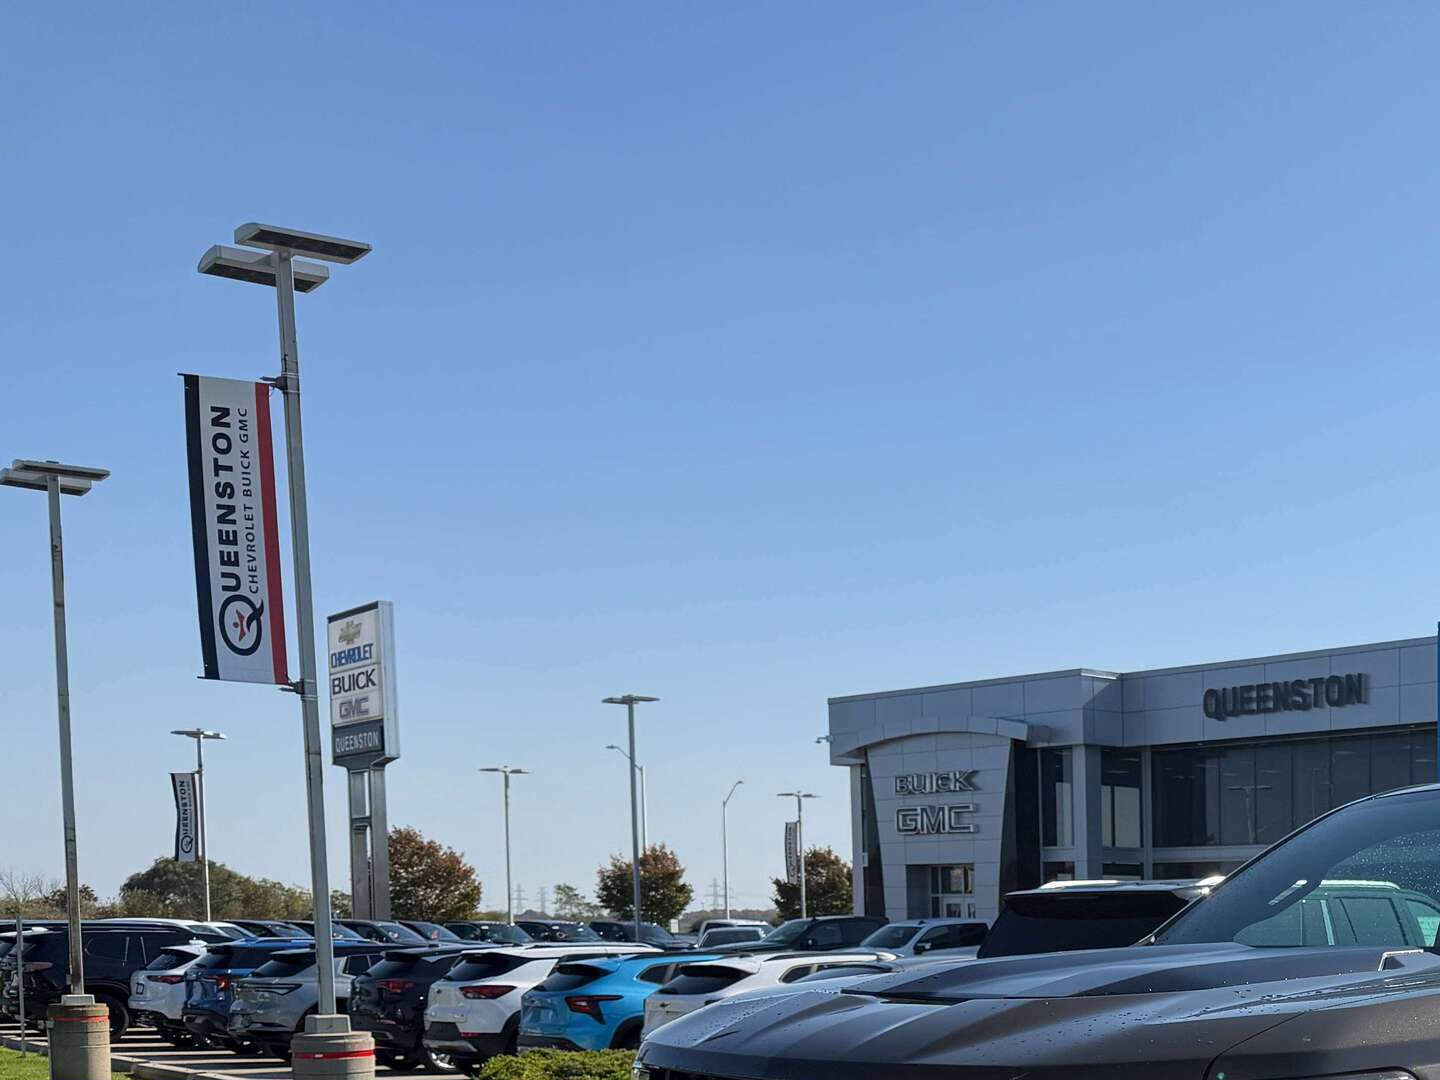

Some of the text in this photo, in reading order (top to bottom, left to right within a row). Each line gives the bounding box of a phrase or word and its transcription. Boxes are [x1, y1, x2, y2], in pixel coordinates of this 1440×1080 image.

[237, 407, 260, 594] CHEVROLET BUICK GMC
[209, 405, 265, 657] QUEENSTON
[330, 642, 374, 669] CHEVROLET
[331, 668, 377, 695] BUICK
[339, 695, 369, 720] GMC
[1202, 672, 1370, 722] QUEENSTON
[335, 730, 380, 754] QUEENSTON
[894, 769, 981, 796] BUICK
[896, 803, 978, 836] GMC
